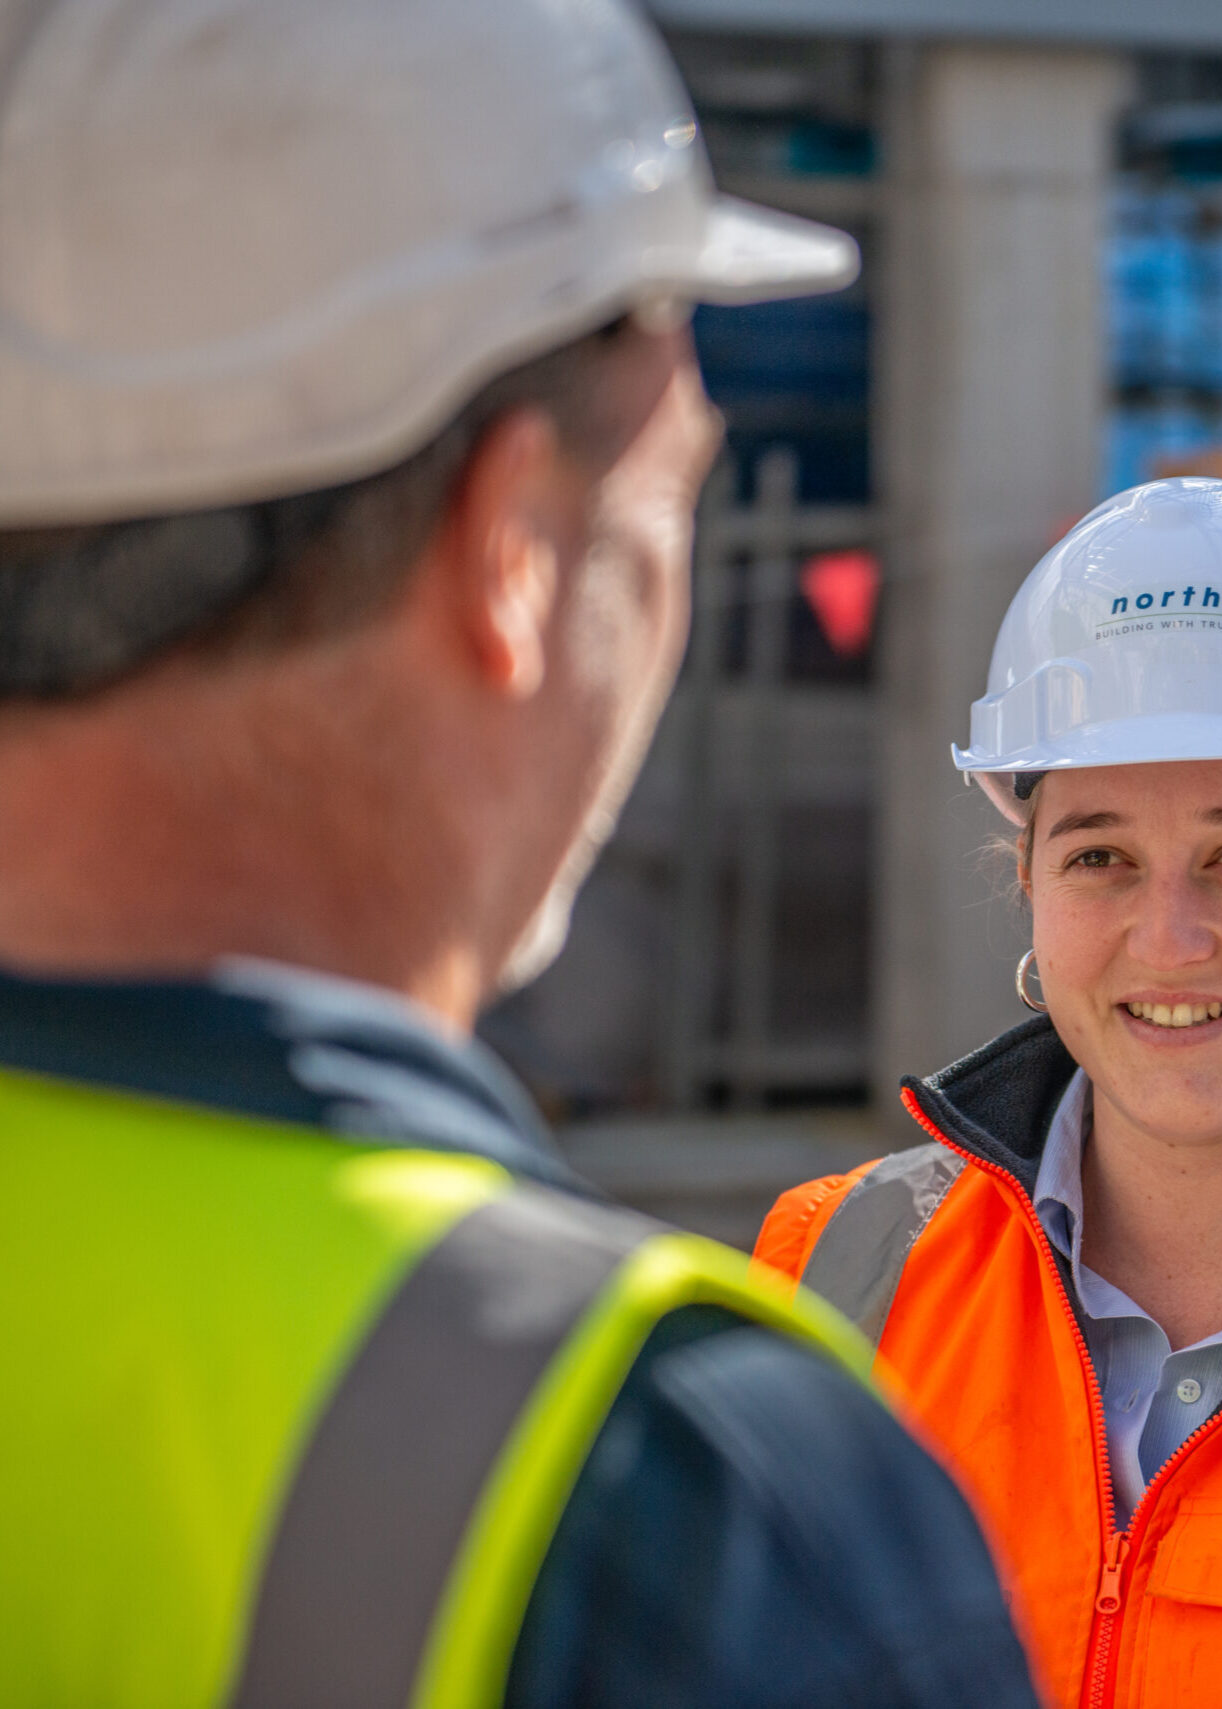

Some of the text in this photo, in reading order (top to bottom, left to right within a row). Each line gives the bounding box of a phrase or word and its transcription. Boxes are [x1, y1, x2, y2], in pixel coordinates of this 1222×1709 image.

[1111, 586, 1220, 614] north
[1096, 622, 1154, 640] BUILDING
[1161, 620, 1194, 629] WITH
